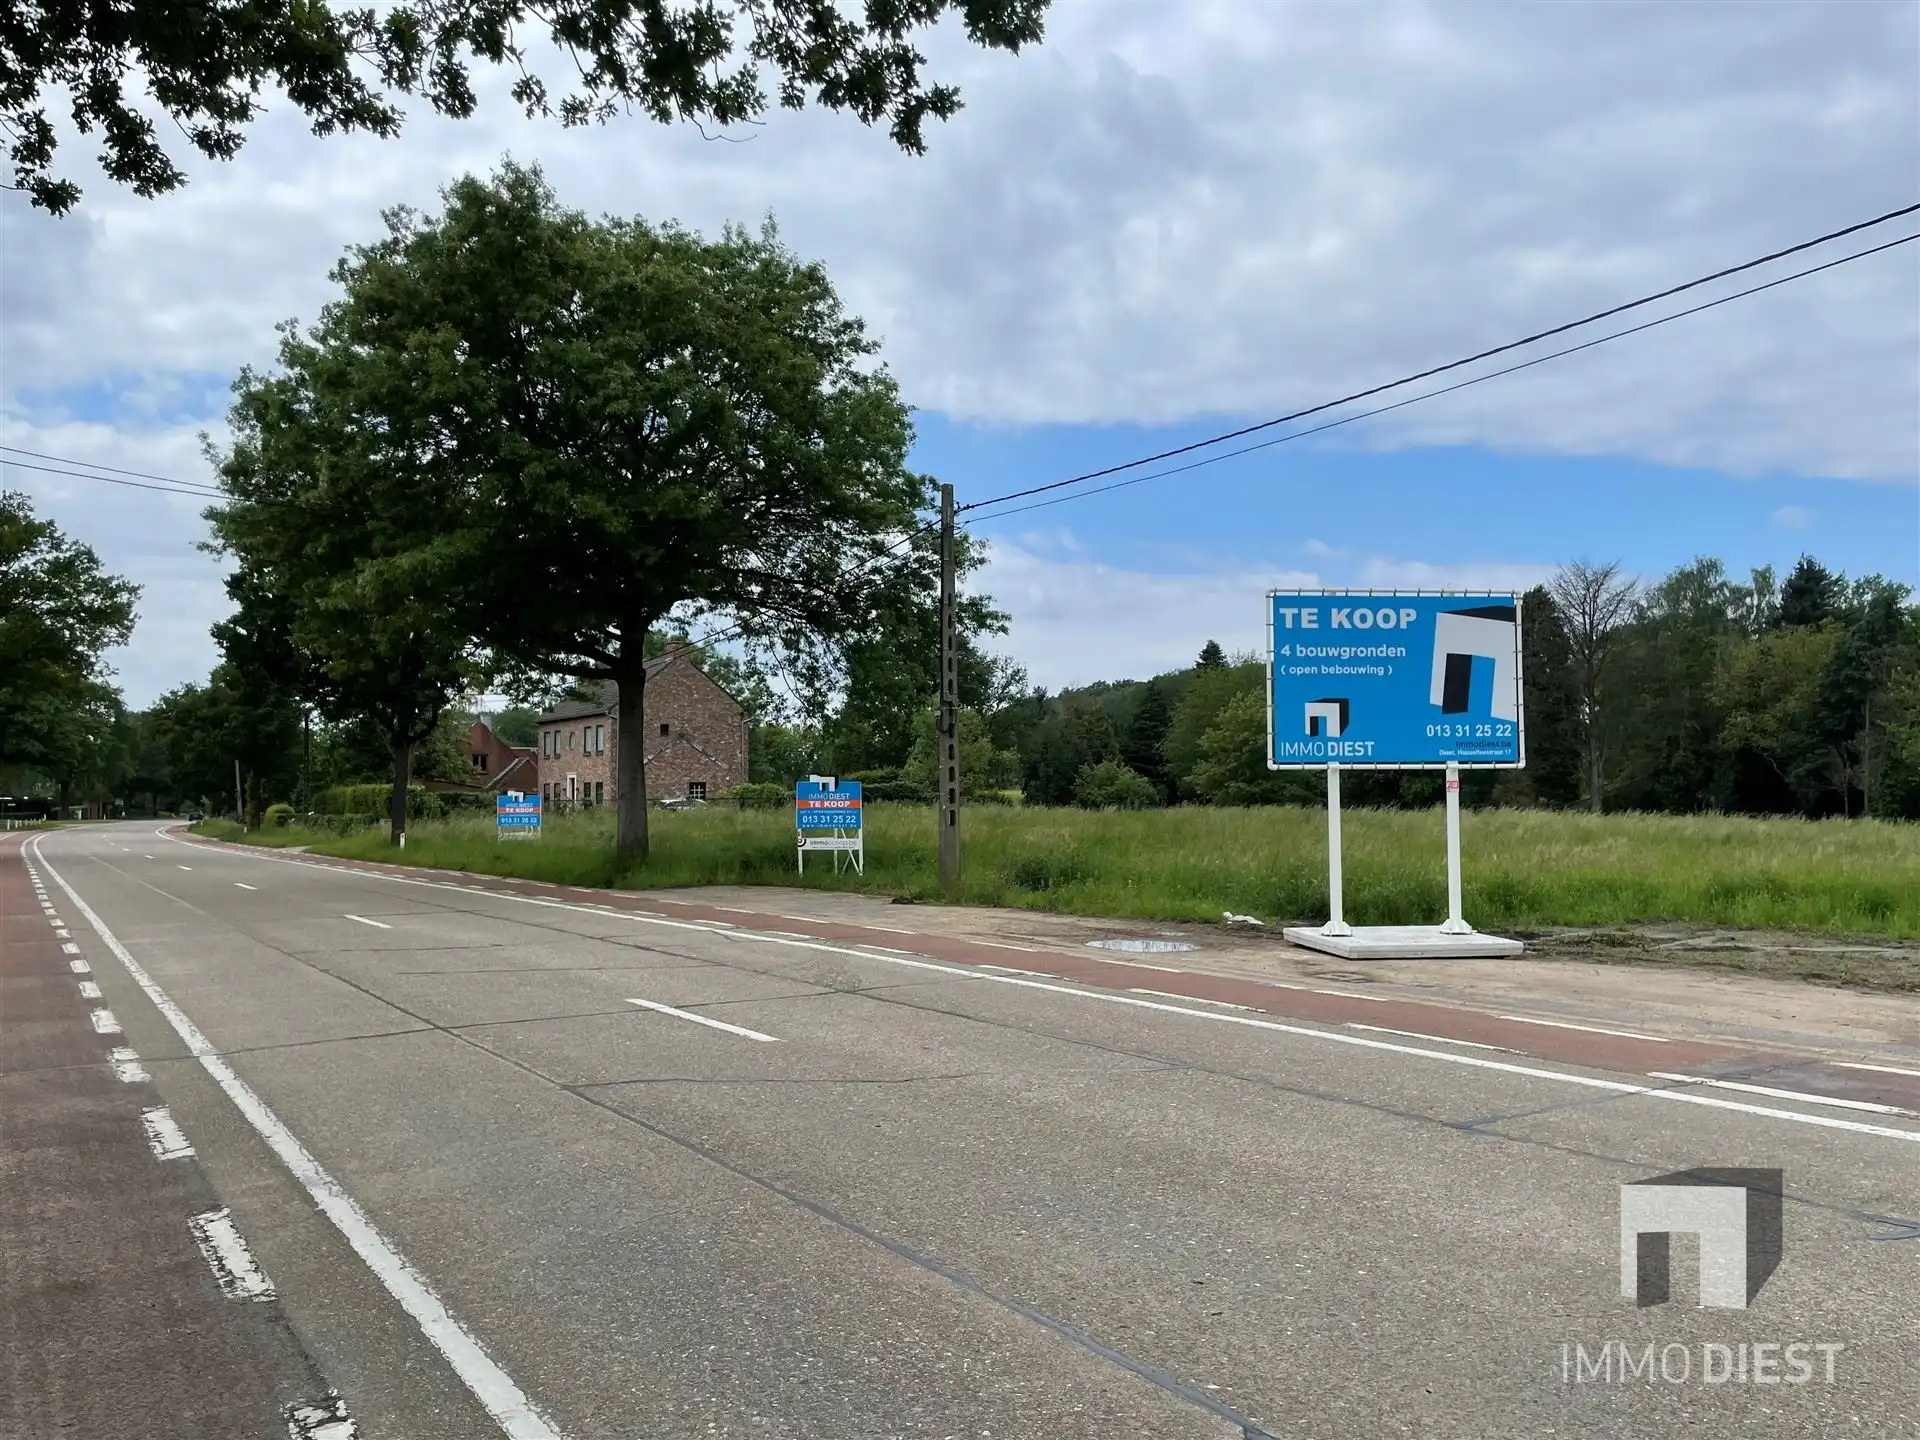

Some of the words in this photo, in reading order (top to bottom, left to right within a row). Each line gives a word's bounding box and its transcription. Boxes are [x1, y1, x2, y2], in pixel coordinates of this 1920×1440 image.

[1279, 608, 1319, 629] TE
[1331, 607, 1418, 630] KOOP
[1280, 644, 1291, 657] 4
[1296, 644, 1406, 660] bouwgronden
[1289, 665, 1318, 676] open
[1321, 664, 1385, 676] bebouwing
[1426, 724, 1451, 737] 013
[1455, 724, 1470, 737] 31
[1475, 724, 1492, 737] 25
[1495, 724, 1512, 737] 22
[1281, 741, 1325, 757] IMMO
[1327, 741, 1375, 757] DIEST
[802, 815, 819, 824] 013
[820, 815, 830, 824] 31
[833, 815, 844, 824] 25
[845, 815, 856, 824] 22
